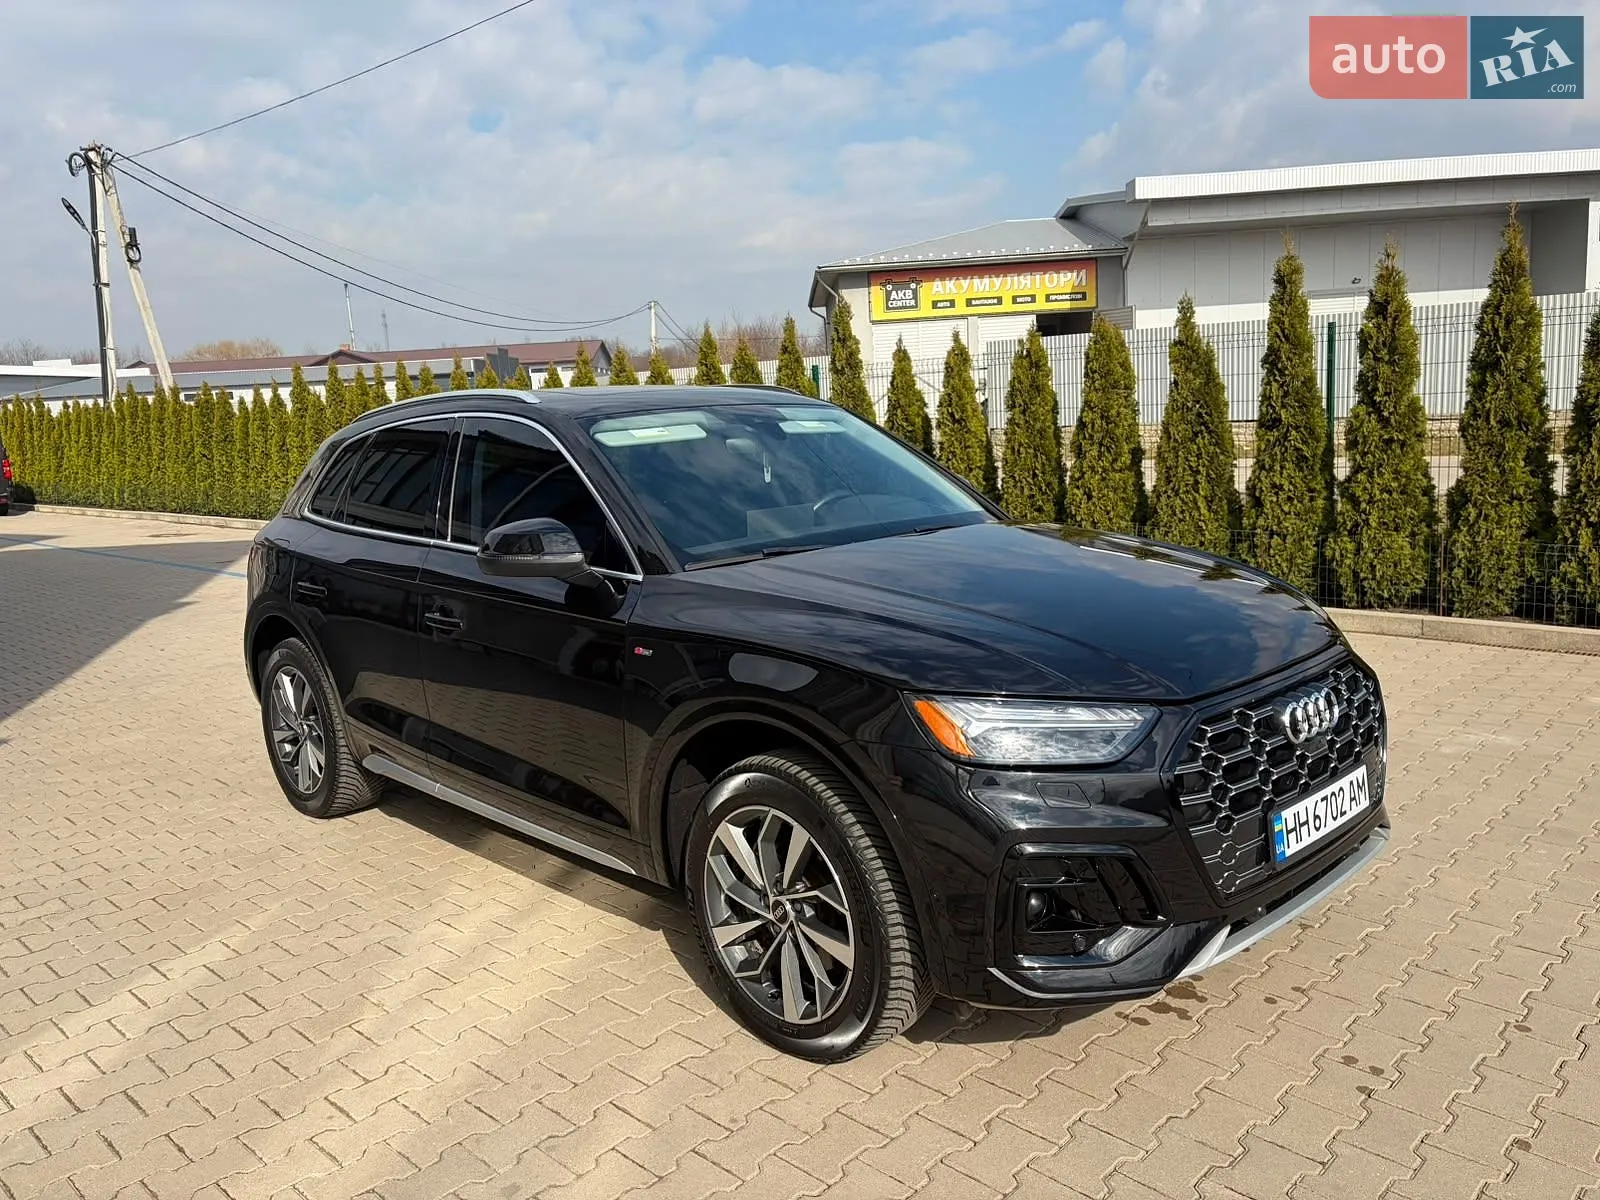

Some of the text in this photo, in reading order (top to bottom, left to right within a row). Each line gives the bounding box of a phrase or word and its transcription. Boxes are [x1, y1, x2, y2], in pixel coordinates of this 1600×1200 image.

[932, 269, 1087, 295] АКУМУЛЯТОРИ
[888, 300, 916, 308] CENTER
[1284, 772, 1367, 849] HH 6702 AM
